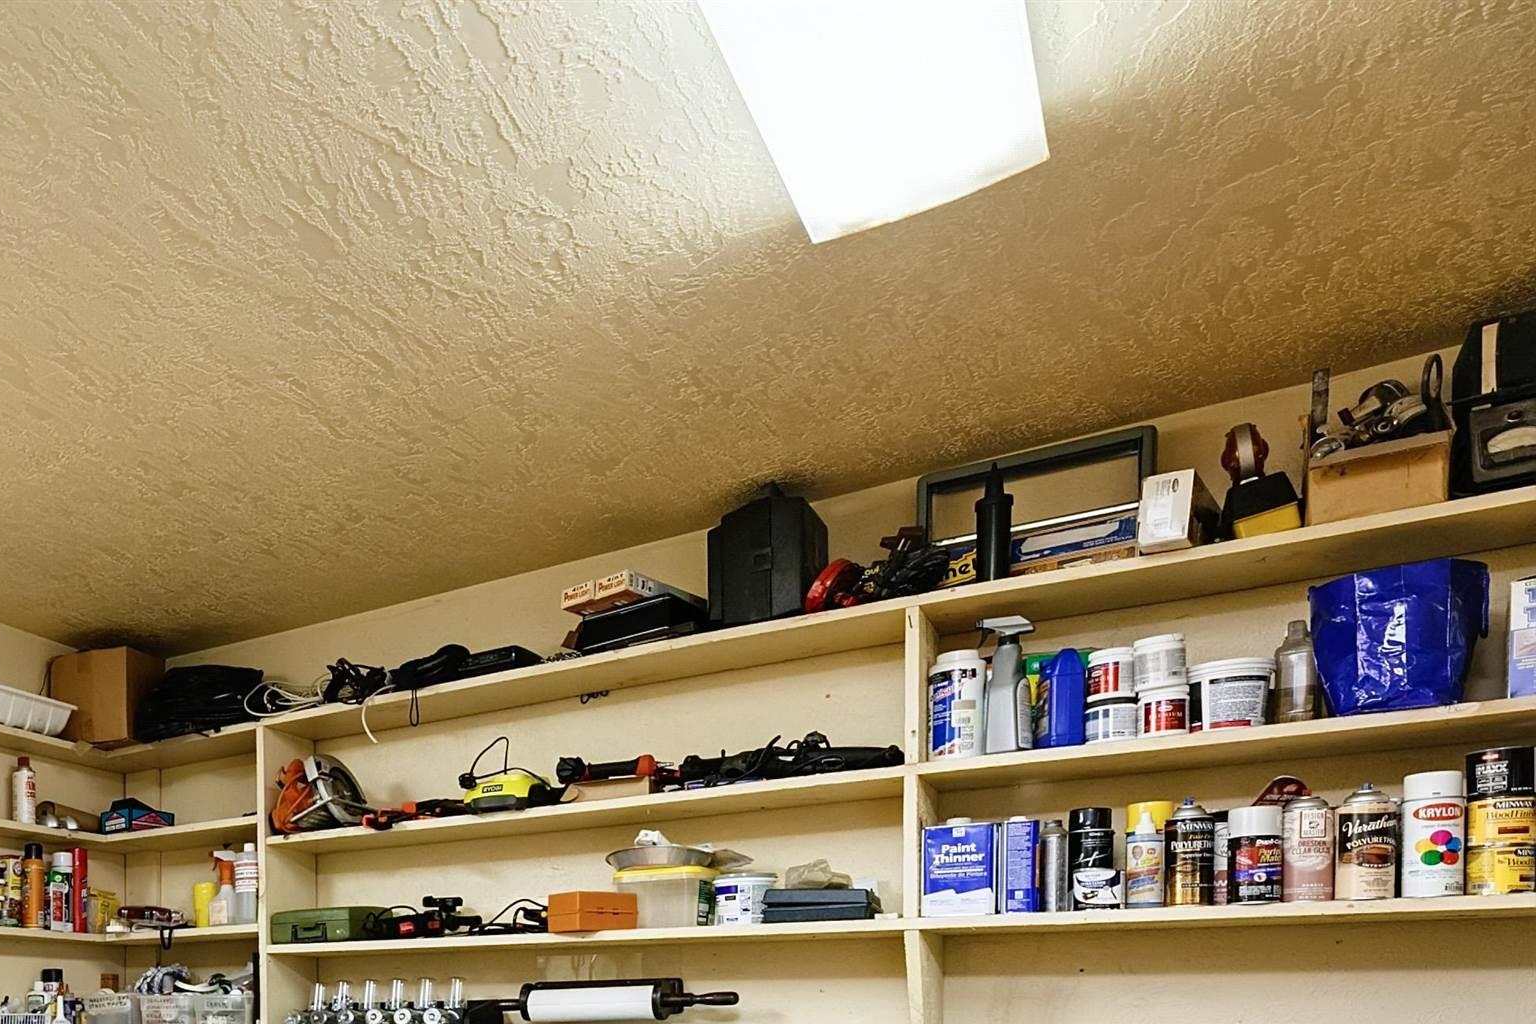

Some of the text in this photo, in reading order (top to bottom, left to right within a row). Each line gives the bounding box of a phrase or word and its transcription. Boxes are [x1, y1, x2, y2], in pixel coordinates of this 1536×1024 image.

[1418, 806, 1461, 819] KRYLON
[941, 843, 977, 854] Paint
[933, 853, 985, 865] Thinner
